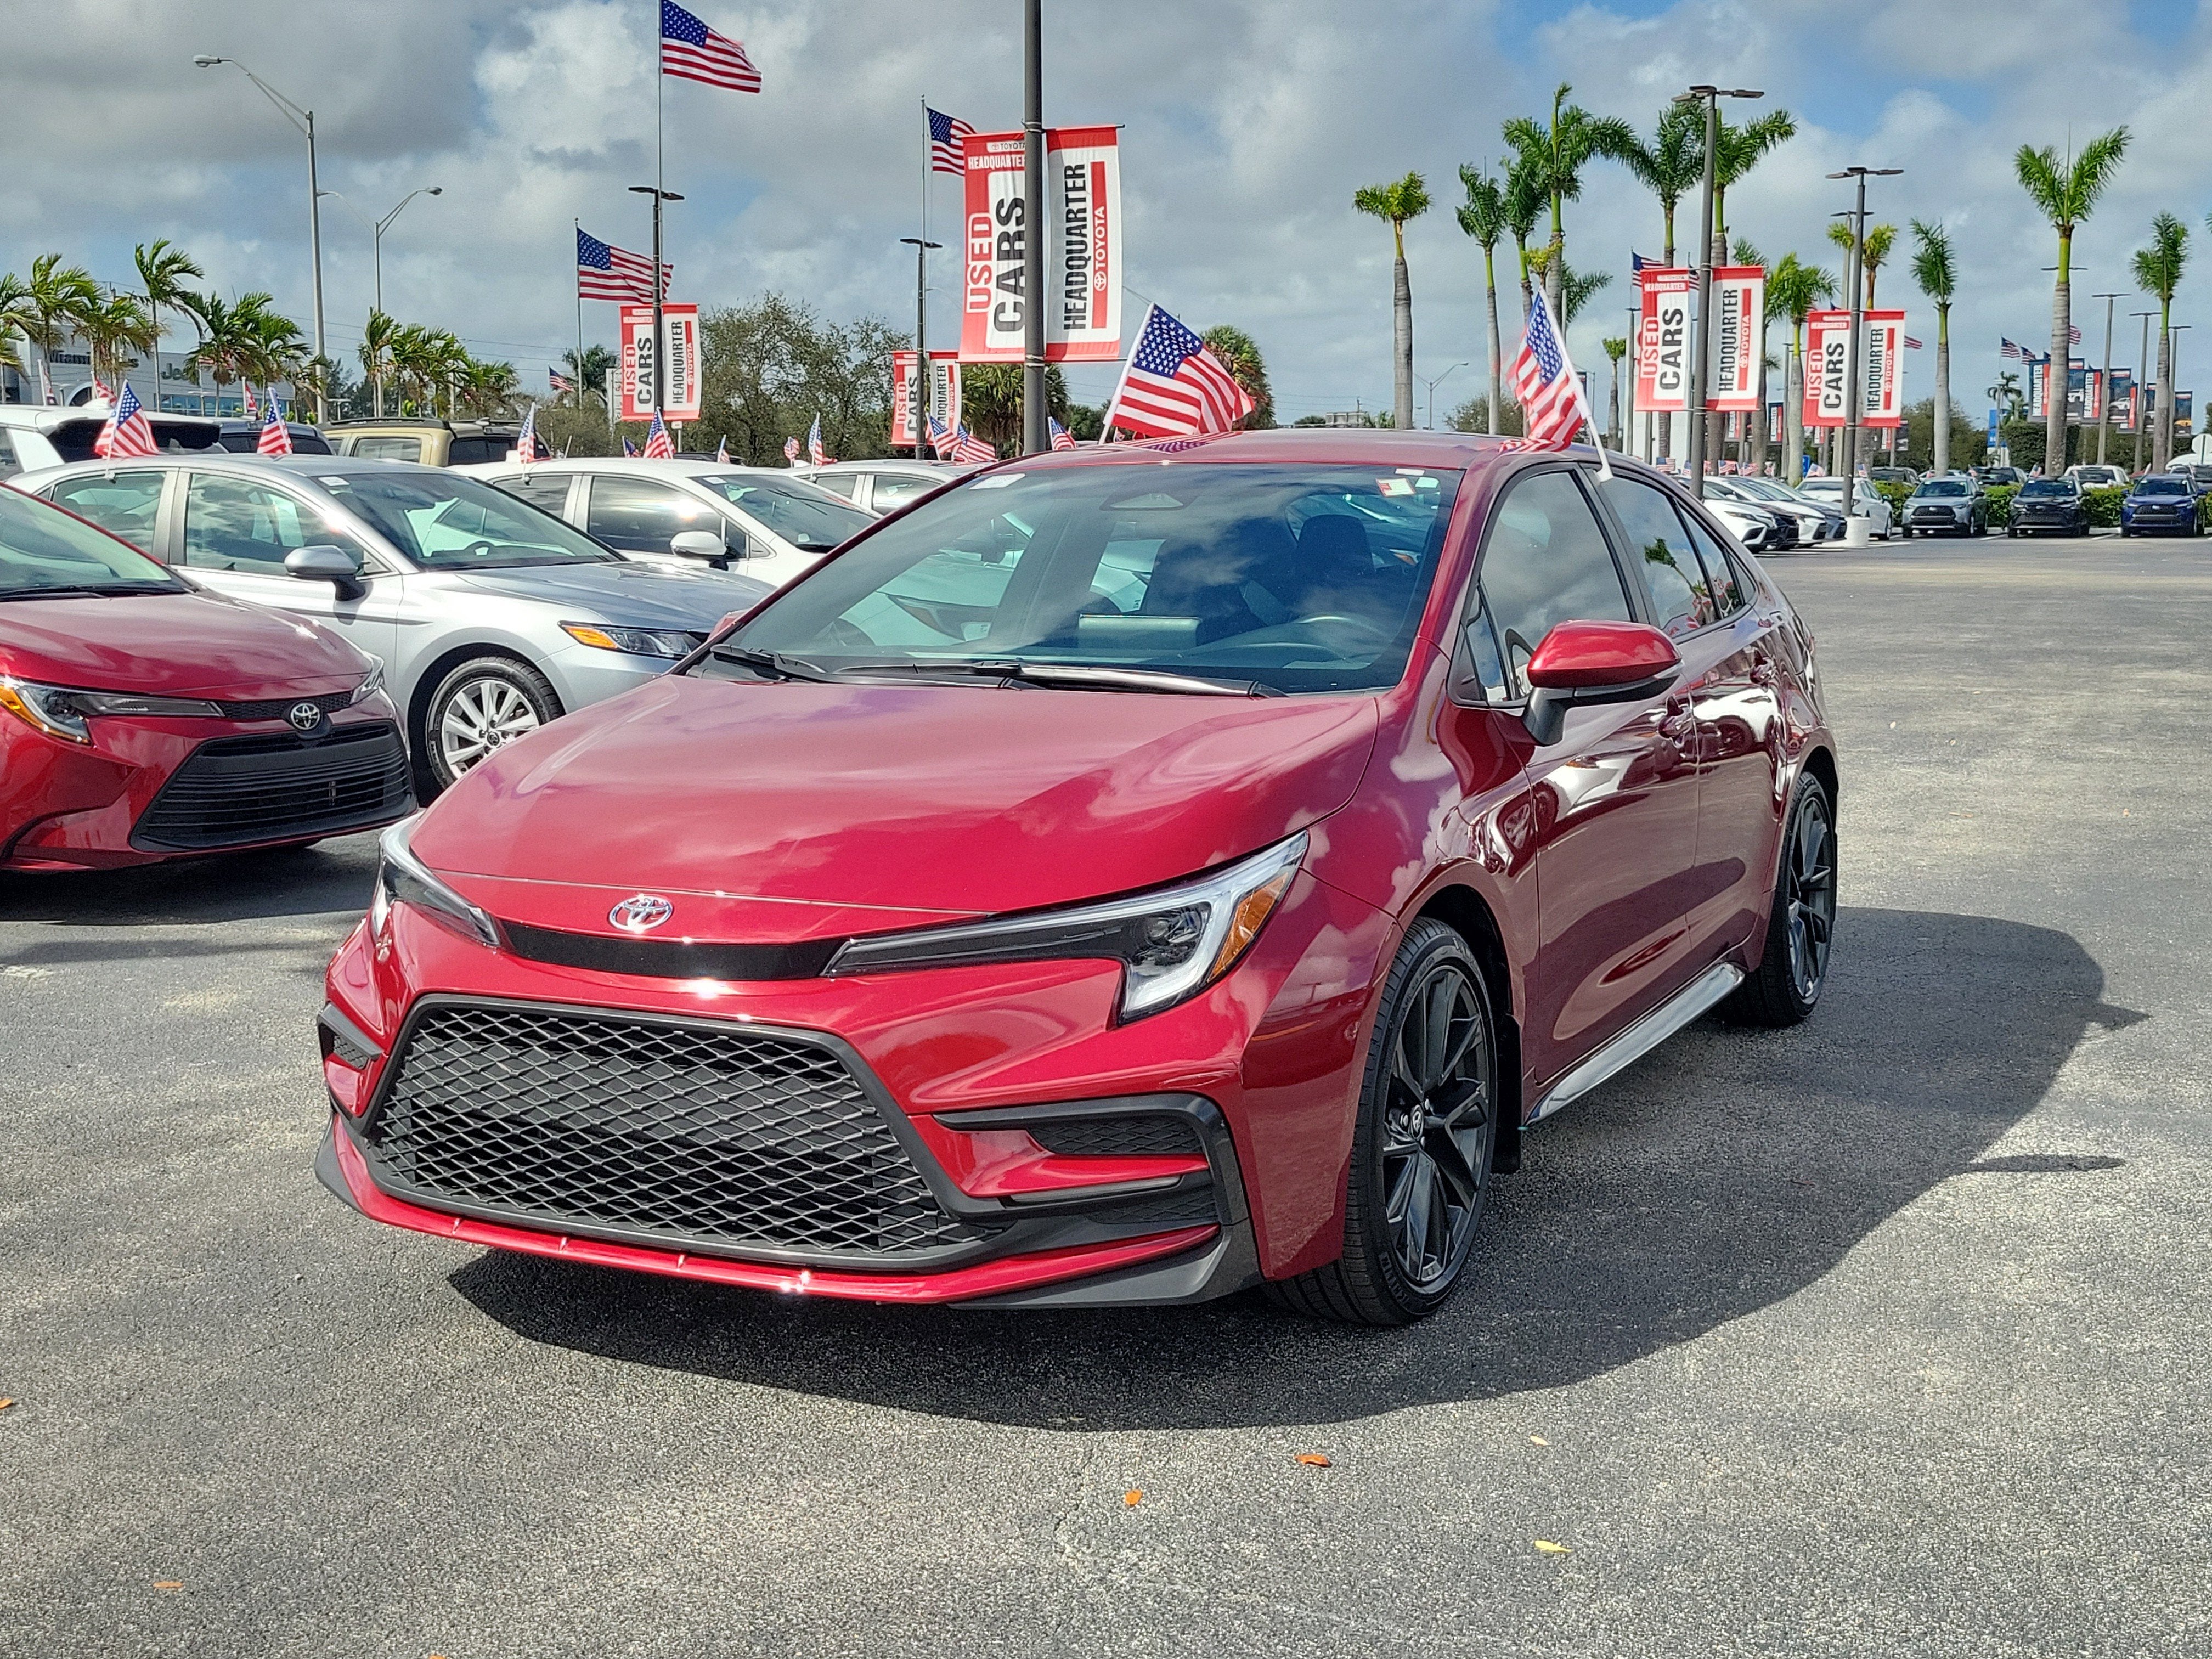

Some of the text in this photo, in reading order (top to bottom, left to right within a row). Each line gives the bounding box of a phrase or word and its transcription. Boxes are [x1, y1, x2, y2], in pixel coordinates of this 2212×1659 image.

[967, 213, 992, 312] USED
[994, 197, 1025, 332] CARS
[1064, 164, 1091, 330] HEADQUARTER
[1094, 206, 1105, 270] TOYOTA
[672, 321, 686, 403] HEADQUARTER
[1643, 320, 1659, 376] USED
[1659, 308, 1683, 390] CARS
[1718, 289, 1738, 391] HEADQUARTER
[1740, 315, 1750, 355] TOYOTA
[625, 346, 636, 392] USED
[637, 337, 652, 404] CARS
[937, 365, 947, 422] ADQUARTER
[1809, 352, 1823, 398] USED
[1824, 343, 1844, 409] CARS
[1867, 328, 1883, 411] HEADQUARTER
[898, 384, 907, 422] USED
